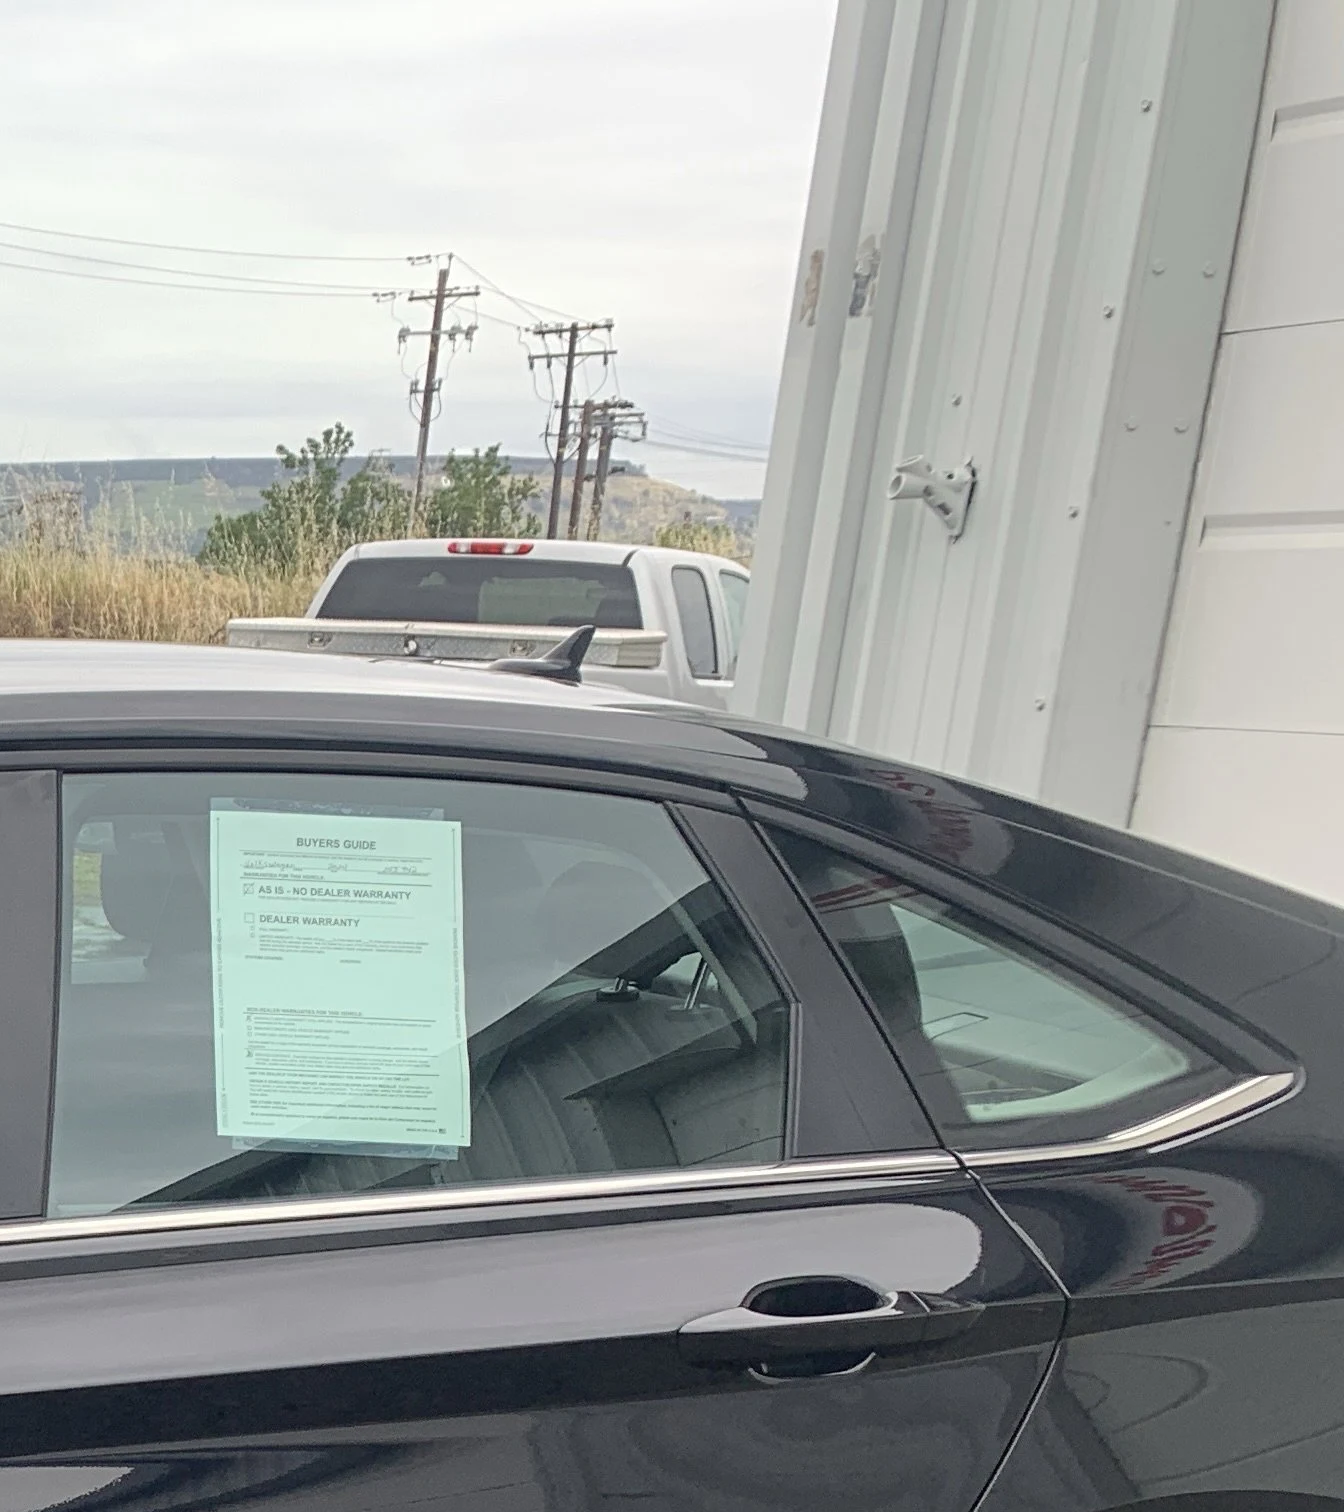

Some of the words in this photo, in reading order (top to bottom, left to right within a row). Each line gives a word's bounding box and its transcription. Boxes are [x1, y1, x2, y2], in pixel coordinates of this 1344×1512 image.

[296, 837, 340, 849] BUYERS
[343, 839, 377, 850] GUIDE
[258, 885, 272, 894] AS
[275, 885, 284, 895] IS
[293, 887, 307, 896] NO
[310, 887, 351, 898] DEALER
[353, 889, 411, 900] WARRANTY
[259, 914, 299, 925] DEALER
[302, 916, 360, 928] WARRANTY
